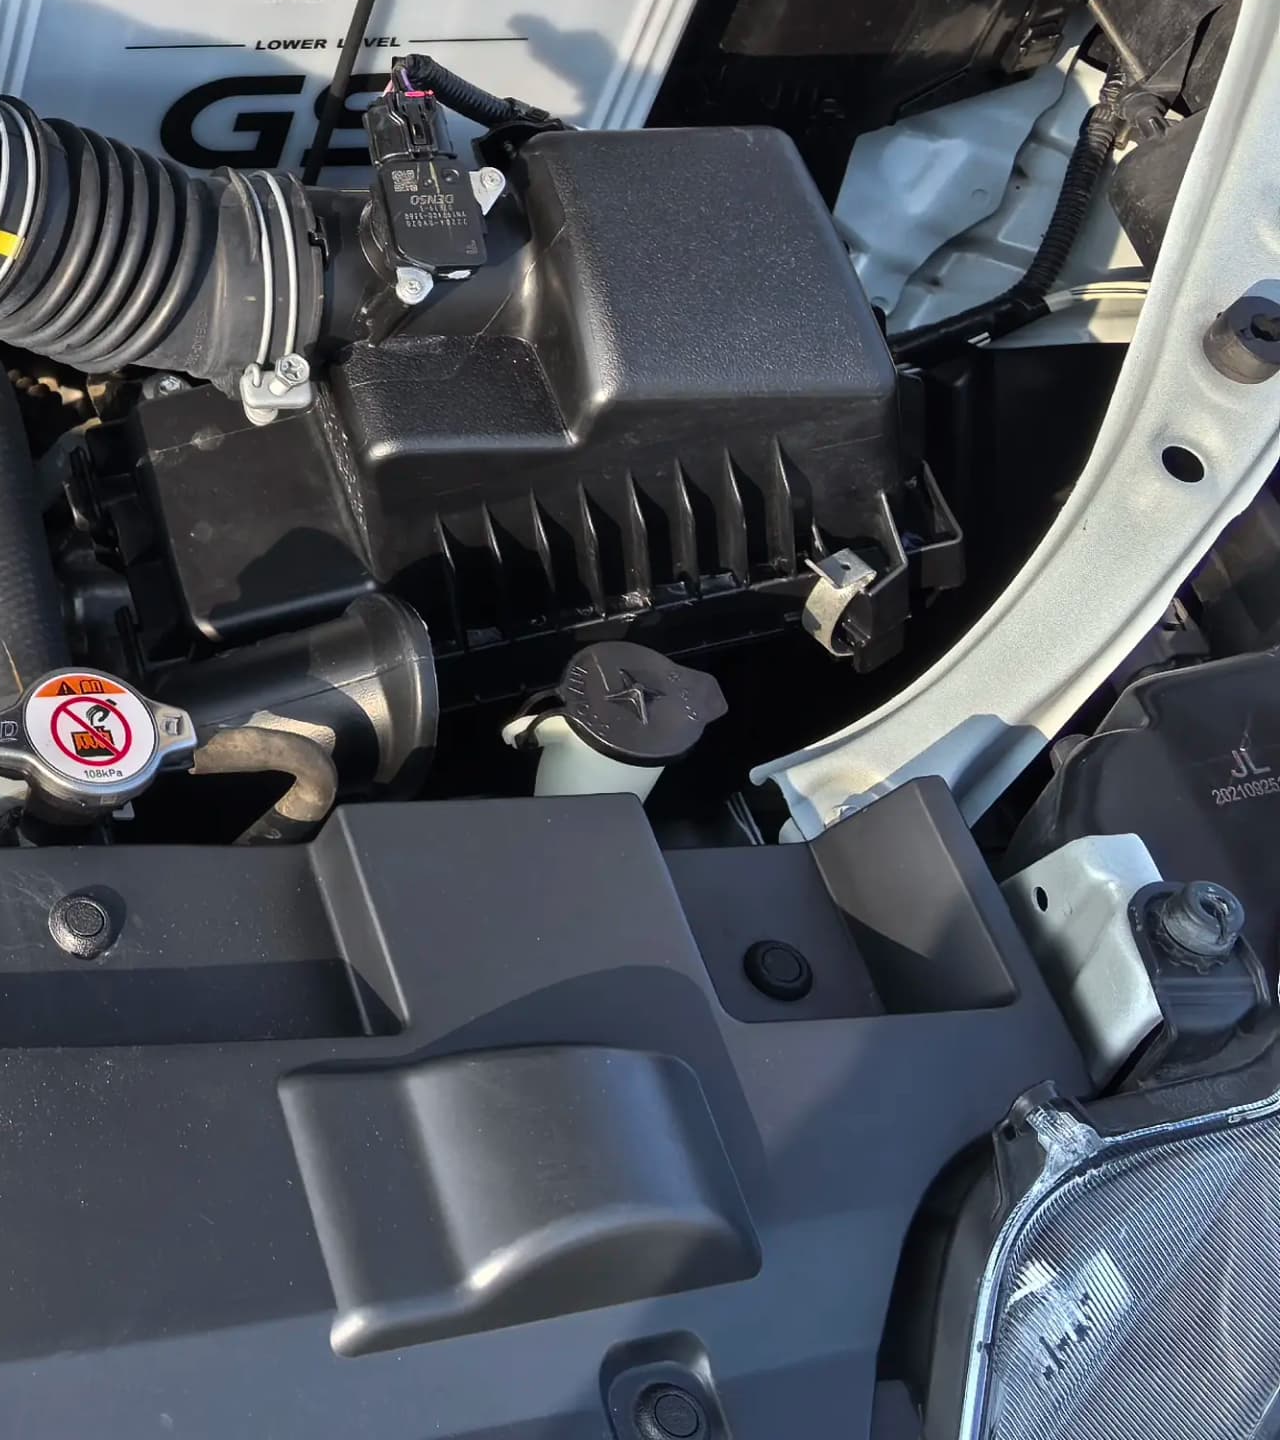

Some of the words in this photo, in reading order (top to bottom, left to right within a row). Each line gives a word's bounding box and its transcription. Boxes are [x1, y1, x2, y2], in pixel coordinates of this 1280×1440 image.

[255, 40, 327, 50] LOWER
[336, 37, 401, 49] LVEL
[410, 194, 454, 205] DENSO
[1231, 749, 1271, 777] JL
[84, 769, 123, 779] 108kPa
